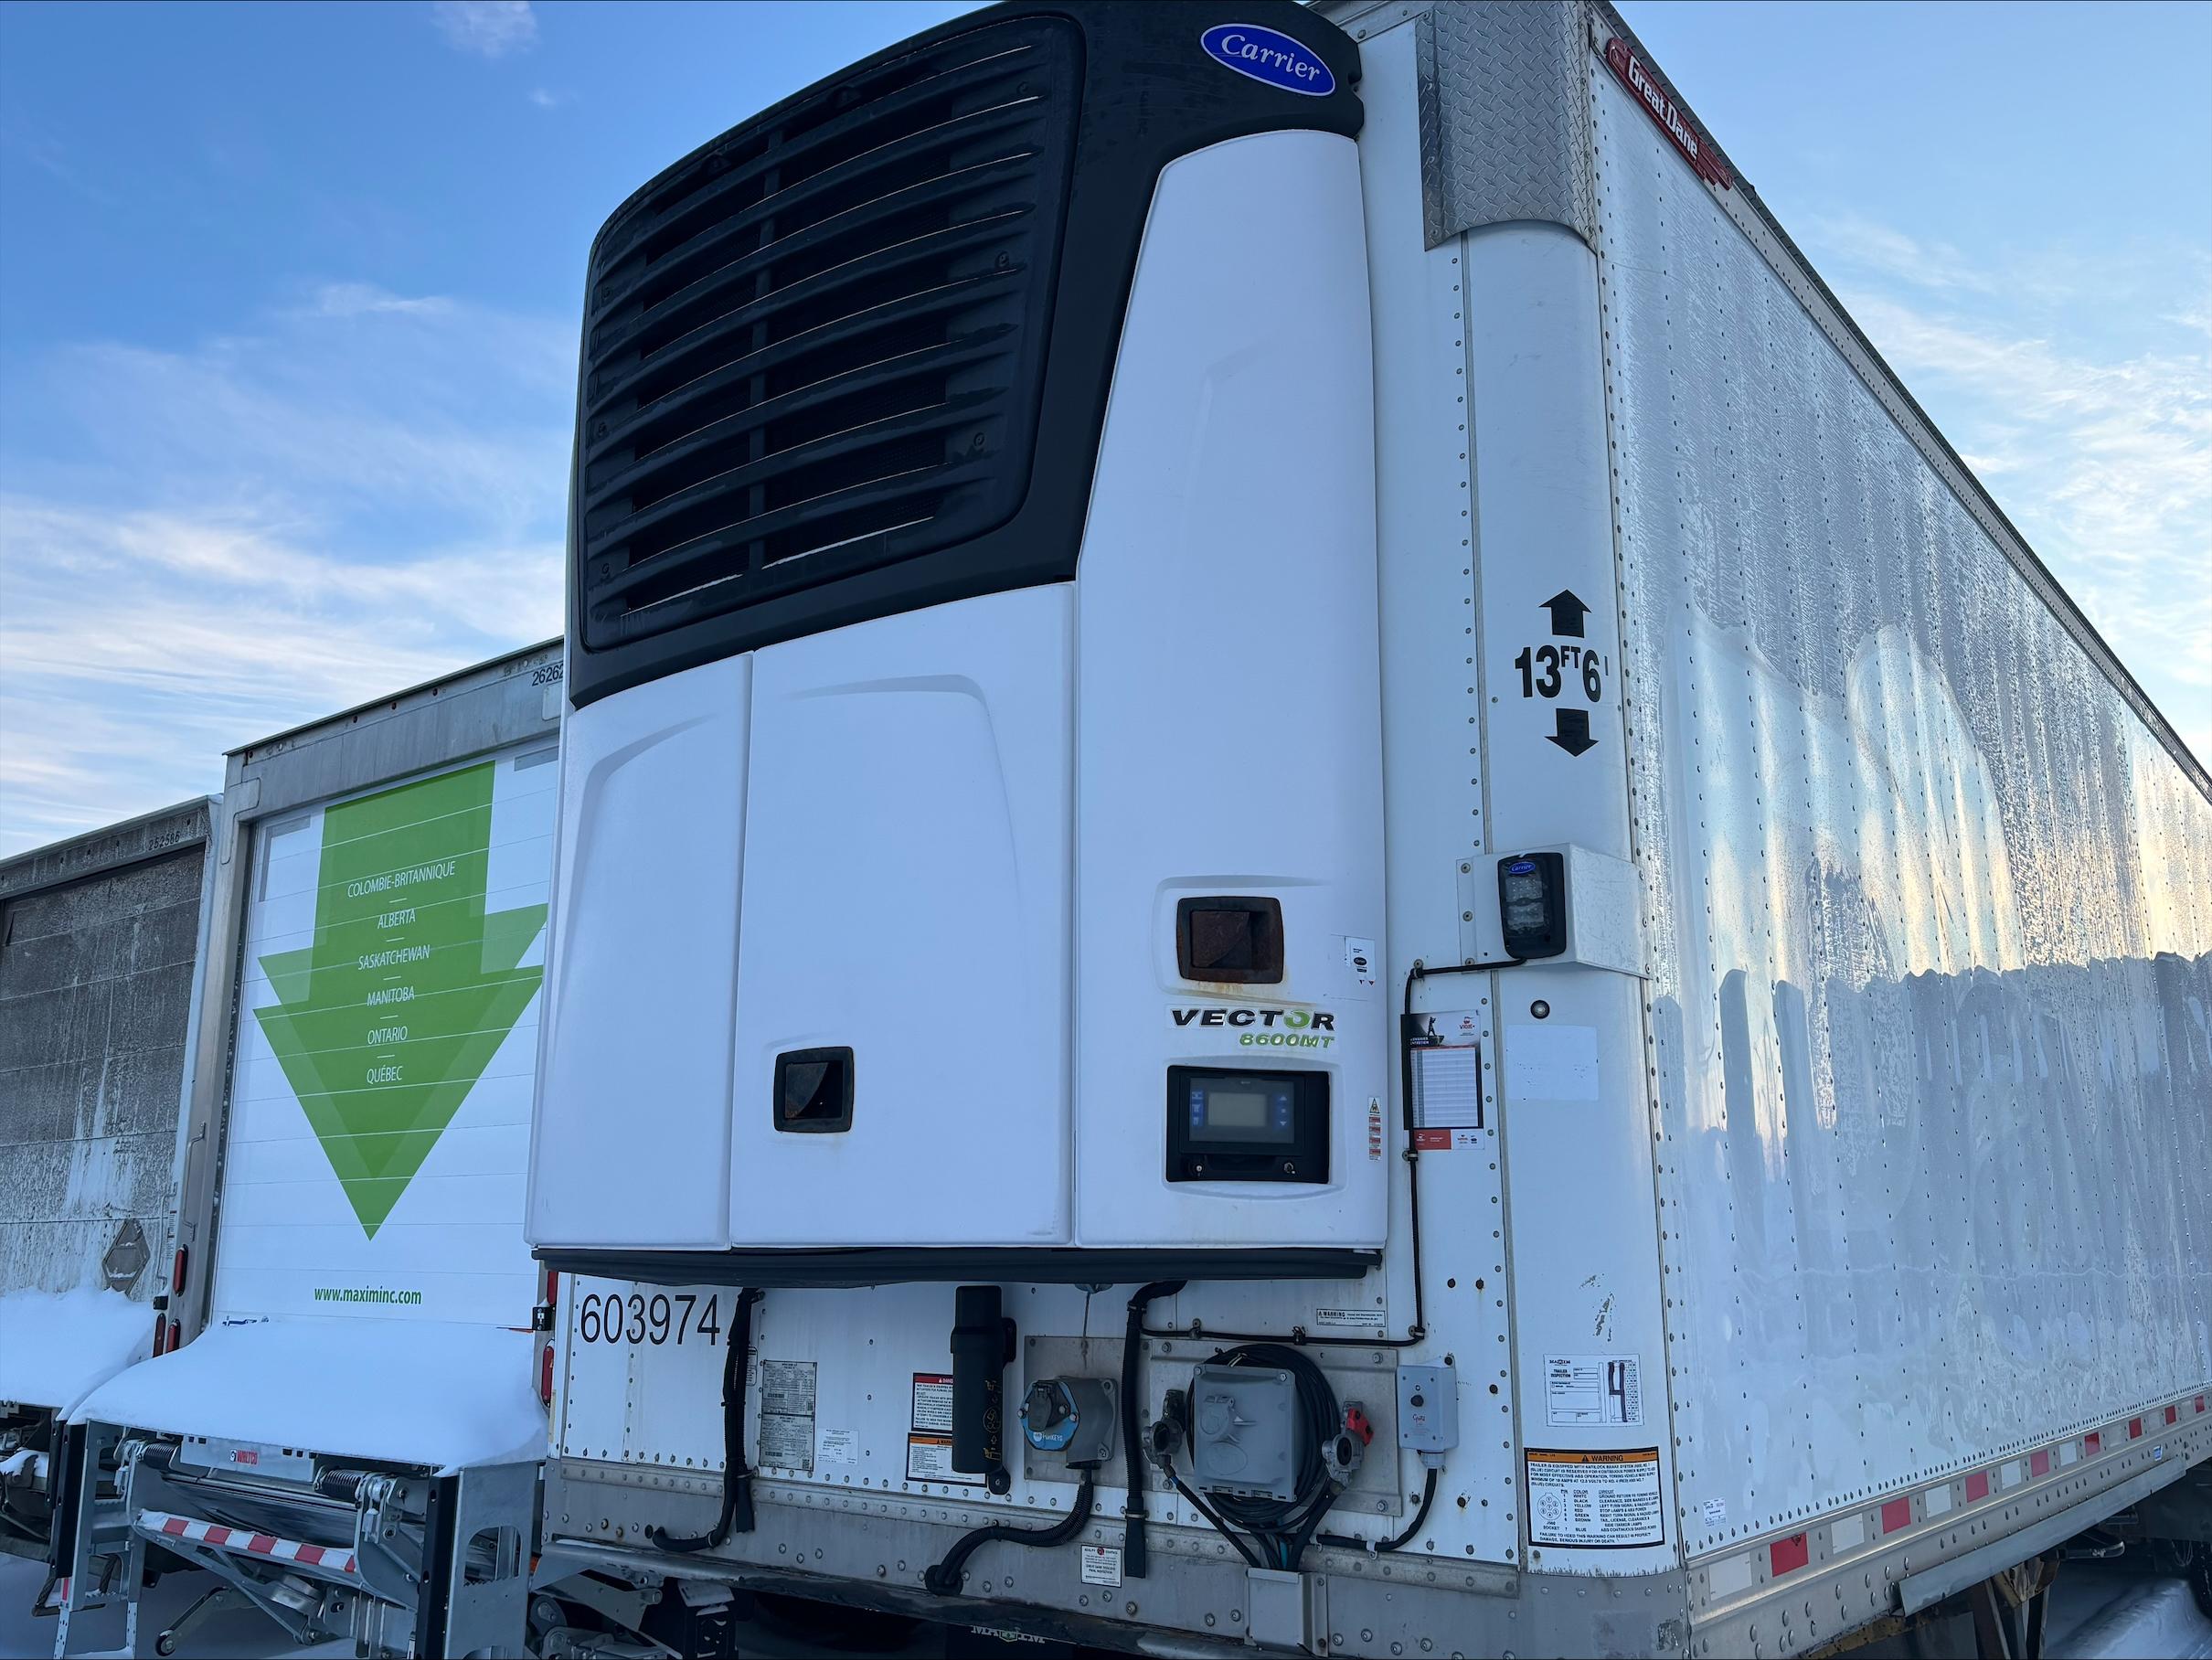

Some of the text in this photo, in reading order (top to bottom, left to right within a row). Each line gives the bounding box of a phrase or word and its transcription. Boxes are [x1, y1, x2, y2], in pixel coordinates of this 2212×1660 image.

[1221, 34, 1320, 81] Carrier
[1628, 55, 1698, 160] Great Dane
[347, 861, 456, 898] COLOMBIE-BRITANNIQUE
[378, 909, 416, 929] ALBERTA
[358, 944, 431, 970] SASKATCHEWAN
[366, 986, 415, 1006] MANITOBA
[1171, 1009, 1335, 1031] VECTOR
[367, 1026, 408, 1045] ONTARIO
[1239, 1033, 1335, 1048] 8600MT
[367, 1064, 403, 1085] QUÉBEC
[314, 1285, 421, 1304] www.maximinc.com
[581, 1293, 721, 1346] 603974
